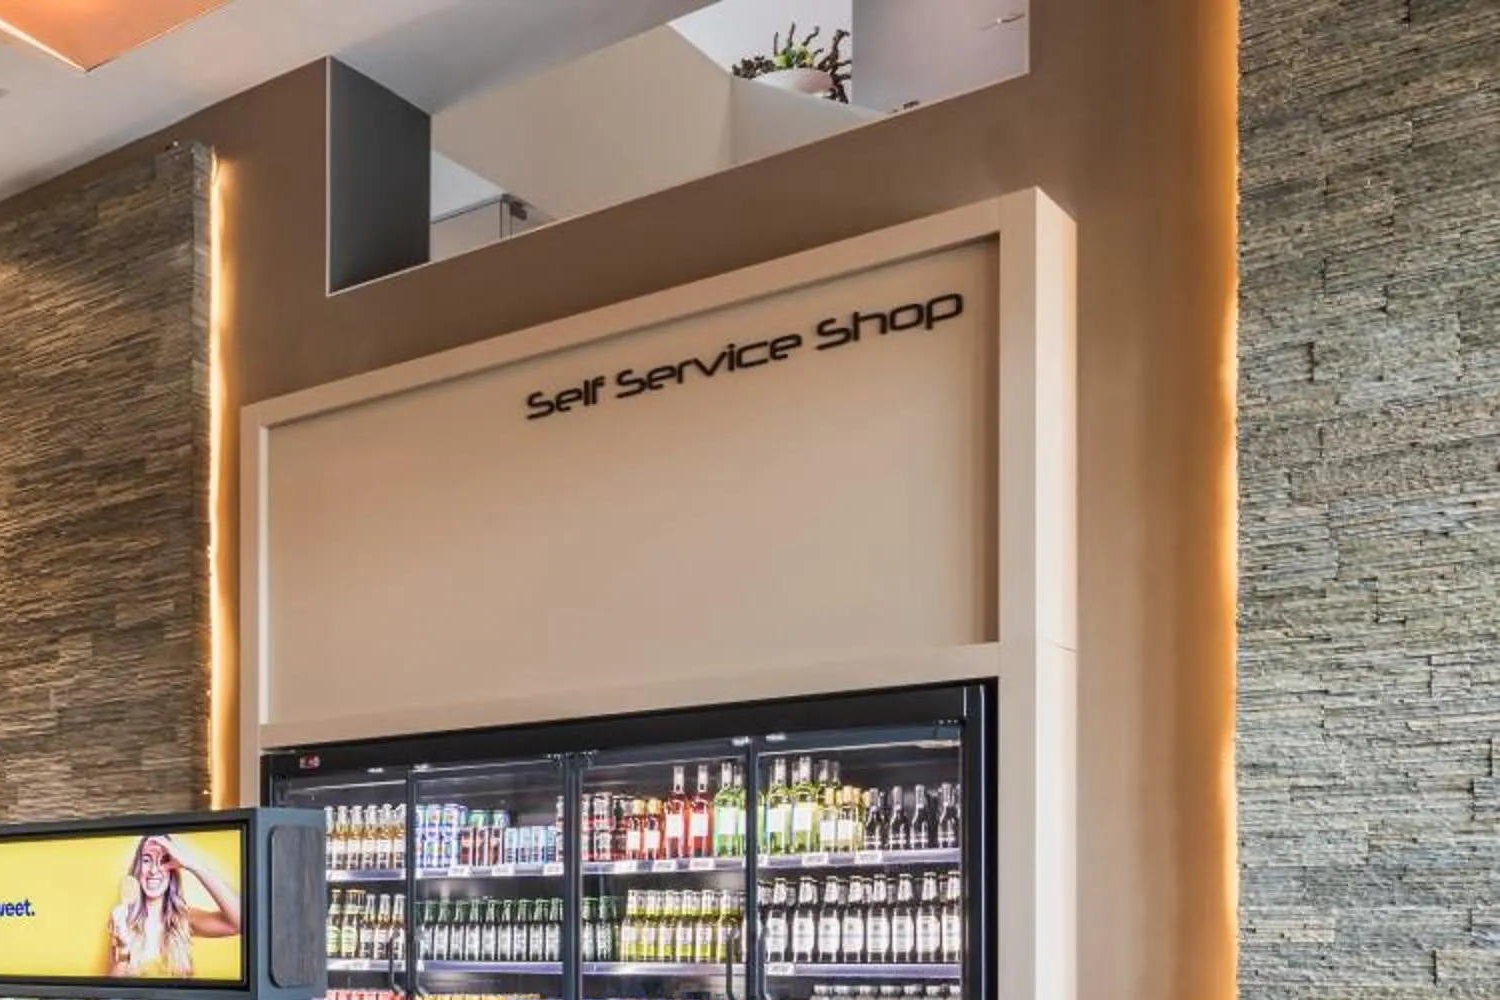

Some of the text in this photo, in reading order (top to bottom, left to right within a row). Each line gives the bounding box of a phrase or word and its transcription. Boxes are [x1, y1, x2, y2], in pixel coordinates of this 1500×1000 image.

[526, 292, 963, 420] Self Service Shop
